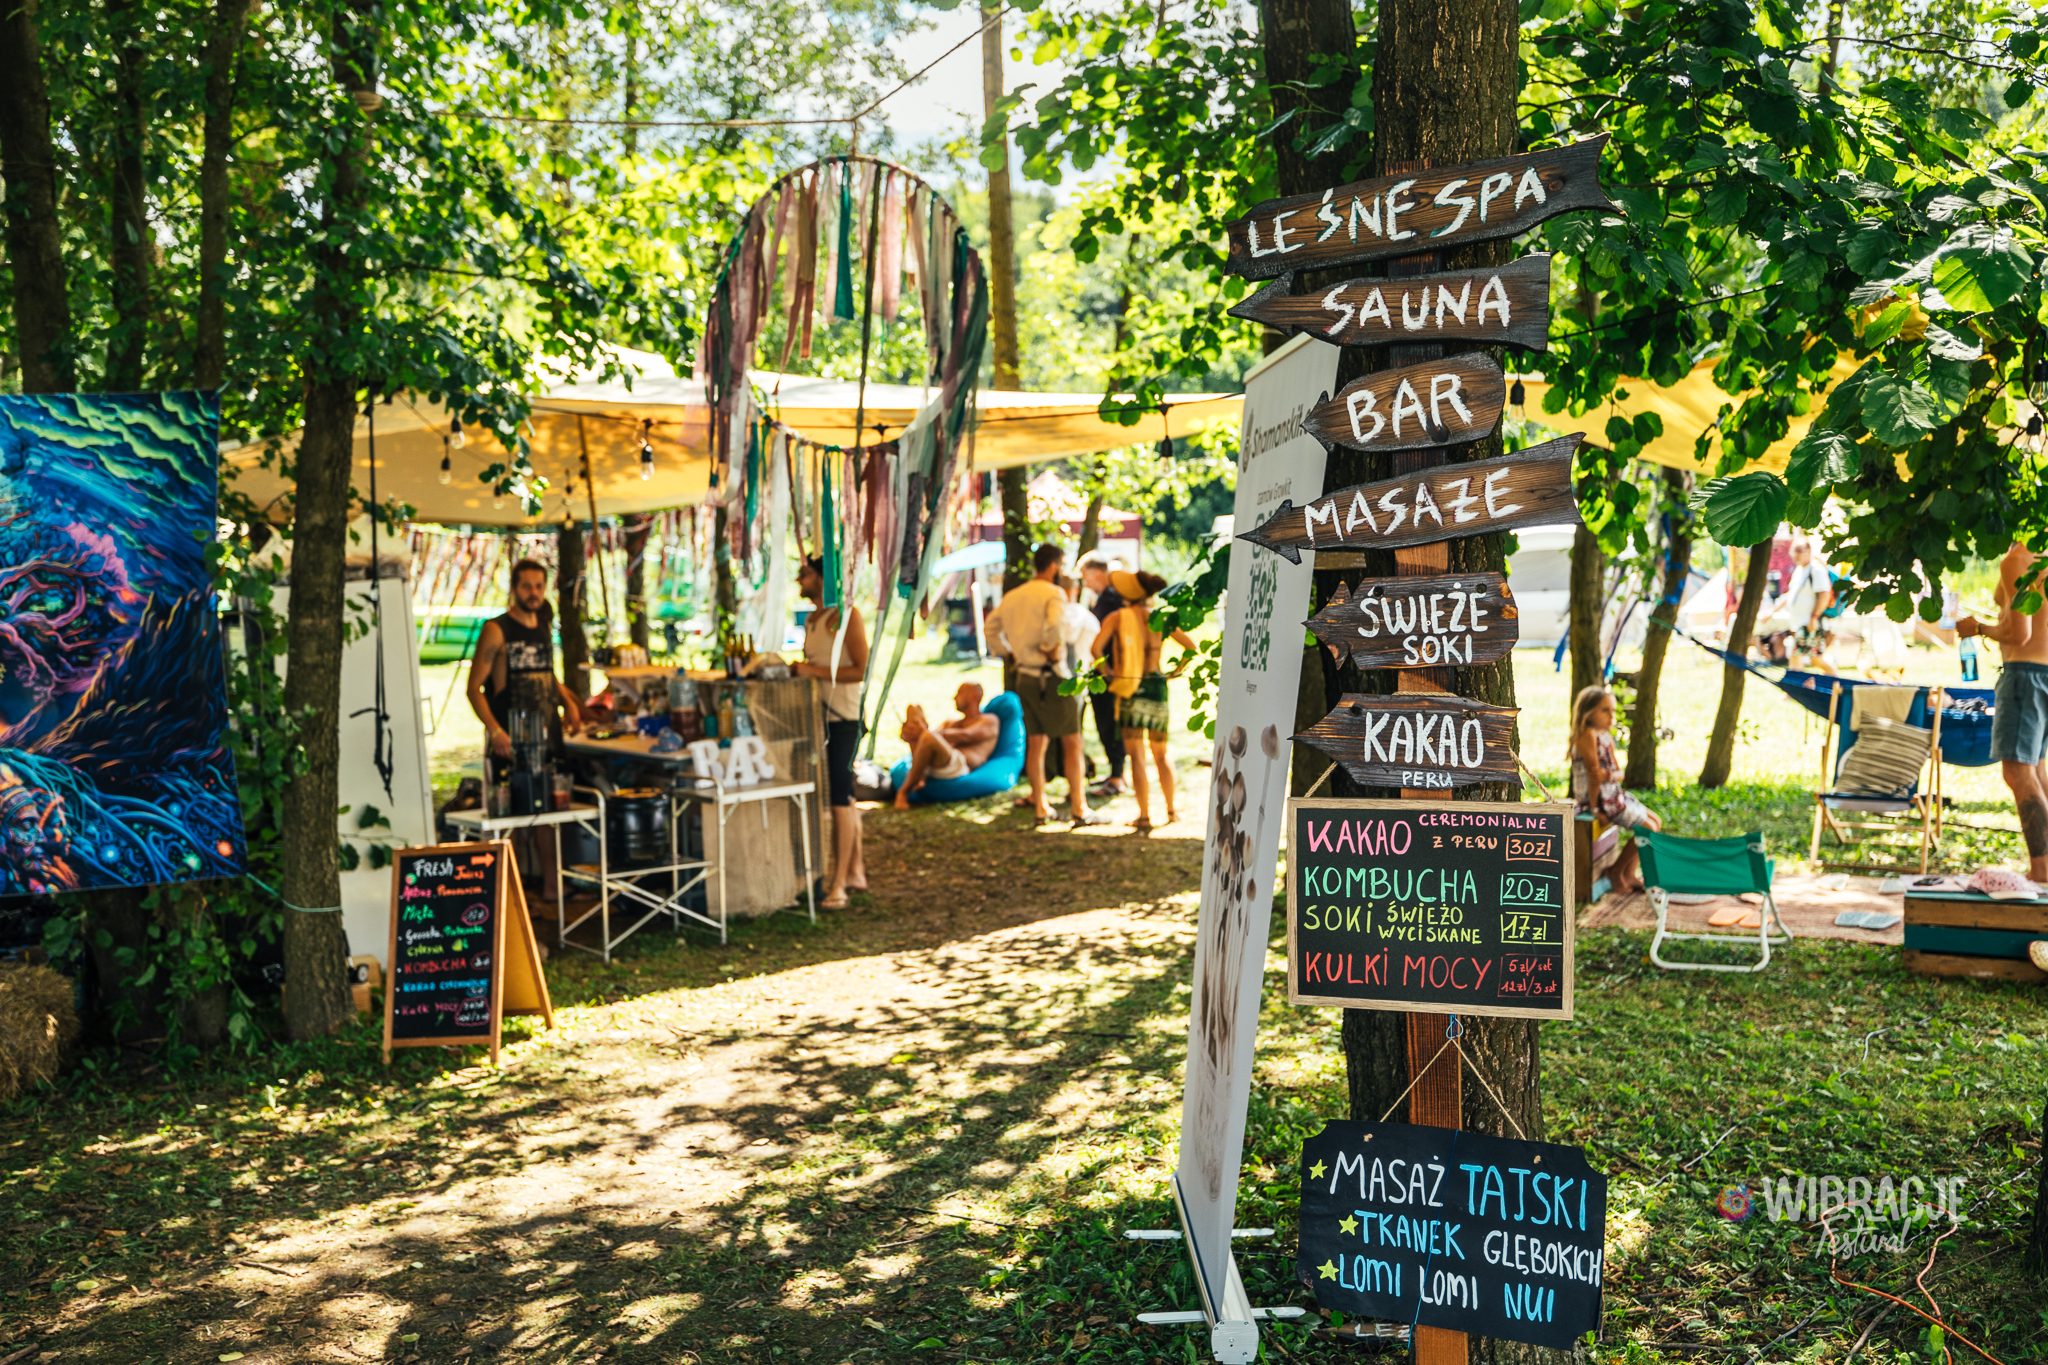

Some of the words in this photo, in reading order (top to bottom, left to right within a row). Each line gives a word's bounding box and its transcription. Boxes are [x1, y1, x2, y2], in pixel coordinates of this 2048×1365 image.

[1429, 167, 1546, 238] SPA
[1322, 274, 1511, 336] SAUNA
[1346, 373, 1474, 444] BAR
[1357, 581, 1489, 638] ŚWIEŻE
[1403, 633, 1473, 666] SOKI
[686, 736, 775, 788] BAR
[1364, 712, 1484, 768] KAKAO
[1402, 771, 1453, 789] PERU
[1307, 819, 1412, 856] KAKAO
[1450, 835, 1498, 850] PERU
[1304, 866, 1478, 904] KOMBUCHA
[1403, 954, 1492, 991] MOCY
[1329, 1150, 1446, 1207] MASAŻ
[1459, 1163, 1587, 1232] TAJSKI
[1354, 1209, 1466, 1261] TKANEK
[1504, 1282, 1554, 1323] NUI
